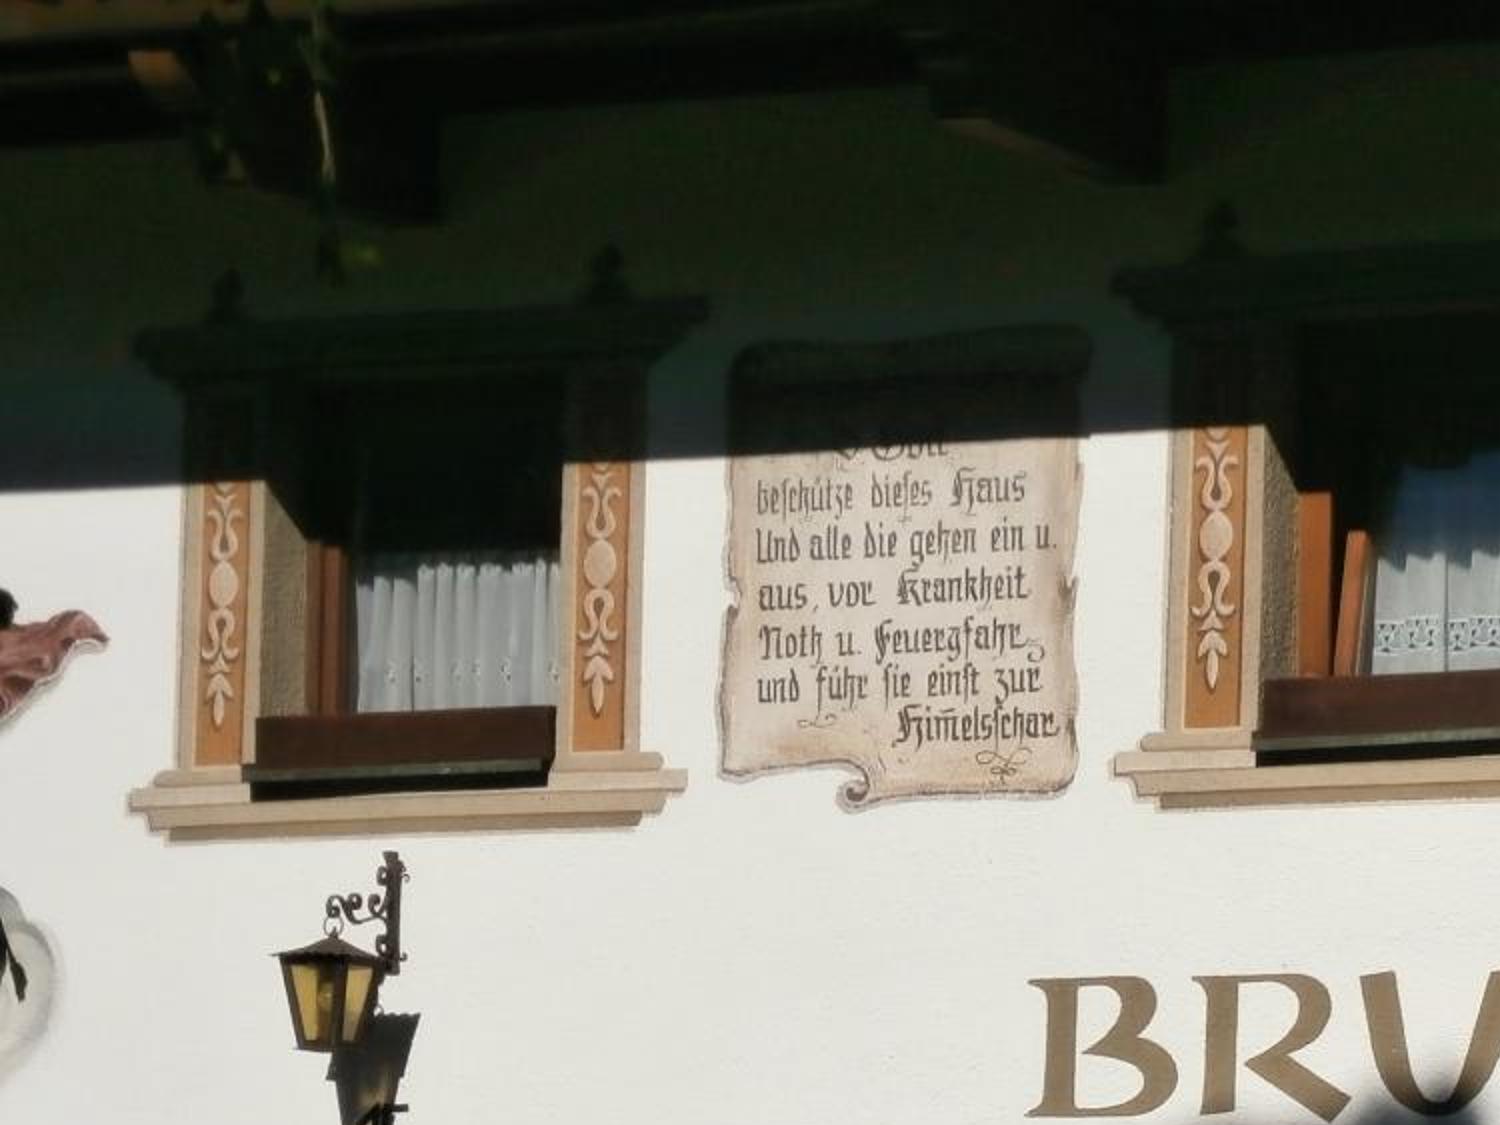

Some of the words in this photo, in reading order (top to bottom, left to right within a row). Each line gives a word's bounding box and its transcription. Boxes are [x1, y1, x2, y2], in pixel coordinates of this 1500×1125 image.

[951, 466, 1028, 516] Haus
[755, 527, 800, 564] Und
[809, 525, 851, 561] alle
[863, 520, 898, 559] die
[909, 520, 977, 563] gehen
[990, 515, 1025, 552] ein
[827, 579, 878, 607] vor
[897, 564, 1030, 608] Krankheit
[758, 624, 822, 666] Noth
[835, 630, 862, 657] u.
[756, 668, 800, 704] und
[994, 665, 1043, 706] zur
